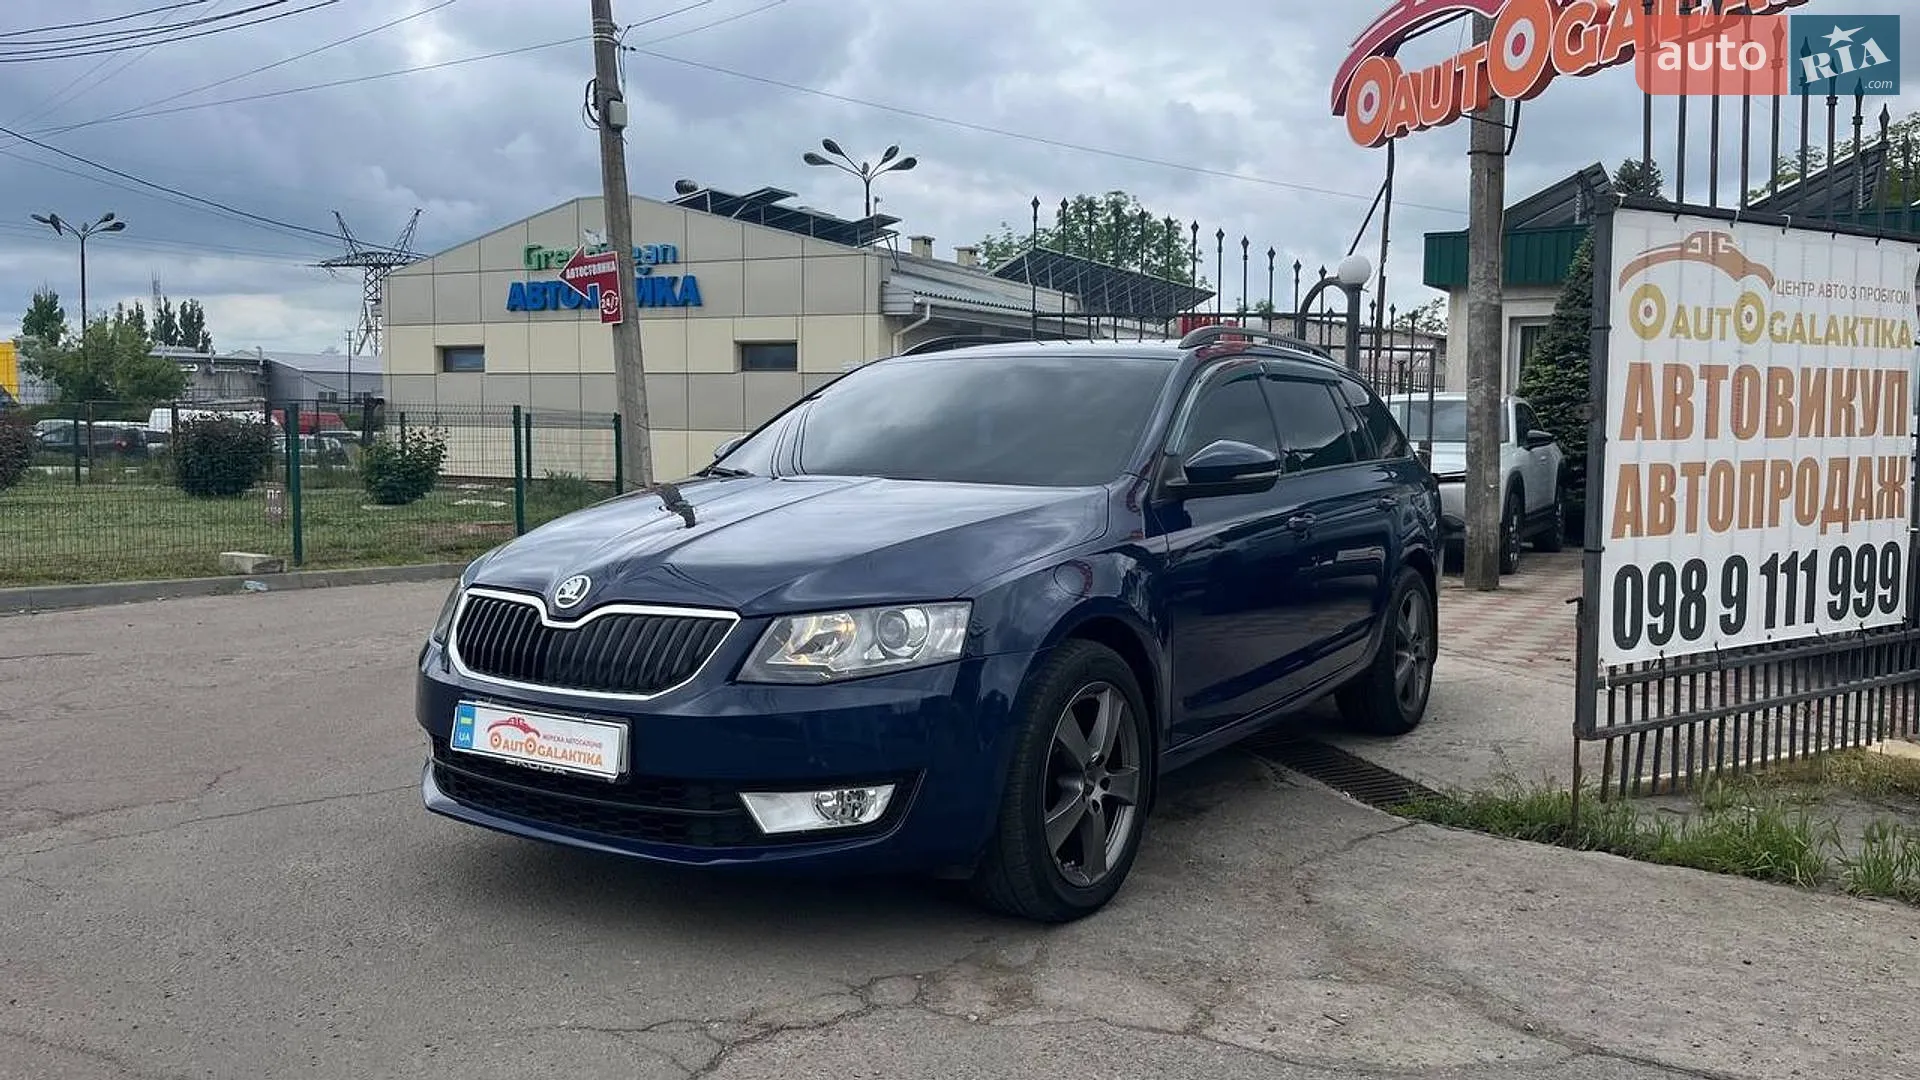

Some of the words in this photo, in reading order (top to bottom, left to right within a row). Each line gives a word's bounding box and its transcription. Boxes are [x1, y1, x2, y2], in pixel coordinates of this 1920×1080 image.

[566, 261, 616, 279] АВТОСТОЯНКА
[1777, 279, 1815, 297] ЦЕНТР
[1818, 283, 1847, 299] АВТО
[1860, 286, 1910, 304] ПРОБІГОМ
[1619, 362, 1909, 441] АВТОВИКУП
[1611, 456, 1907, 539] АВТОПРОДАЖ
[1612, 558, 1709, 651] 098
[1720, 554, 1748, 635] 9
[1760, 549, 1818, 630] 111
[1827, 541, 1902, 622] 999
[459, 732, 471, 742] UA
